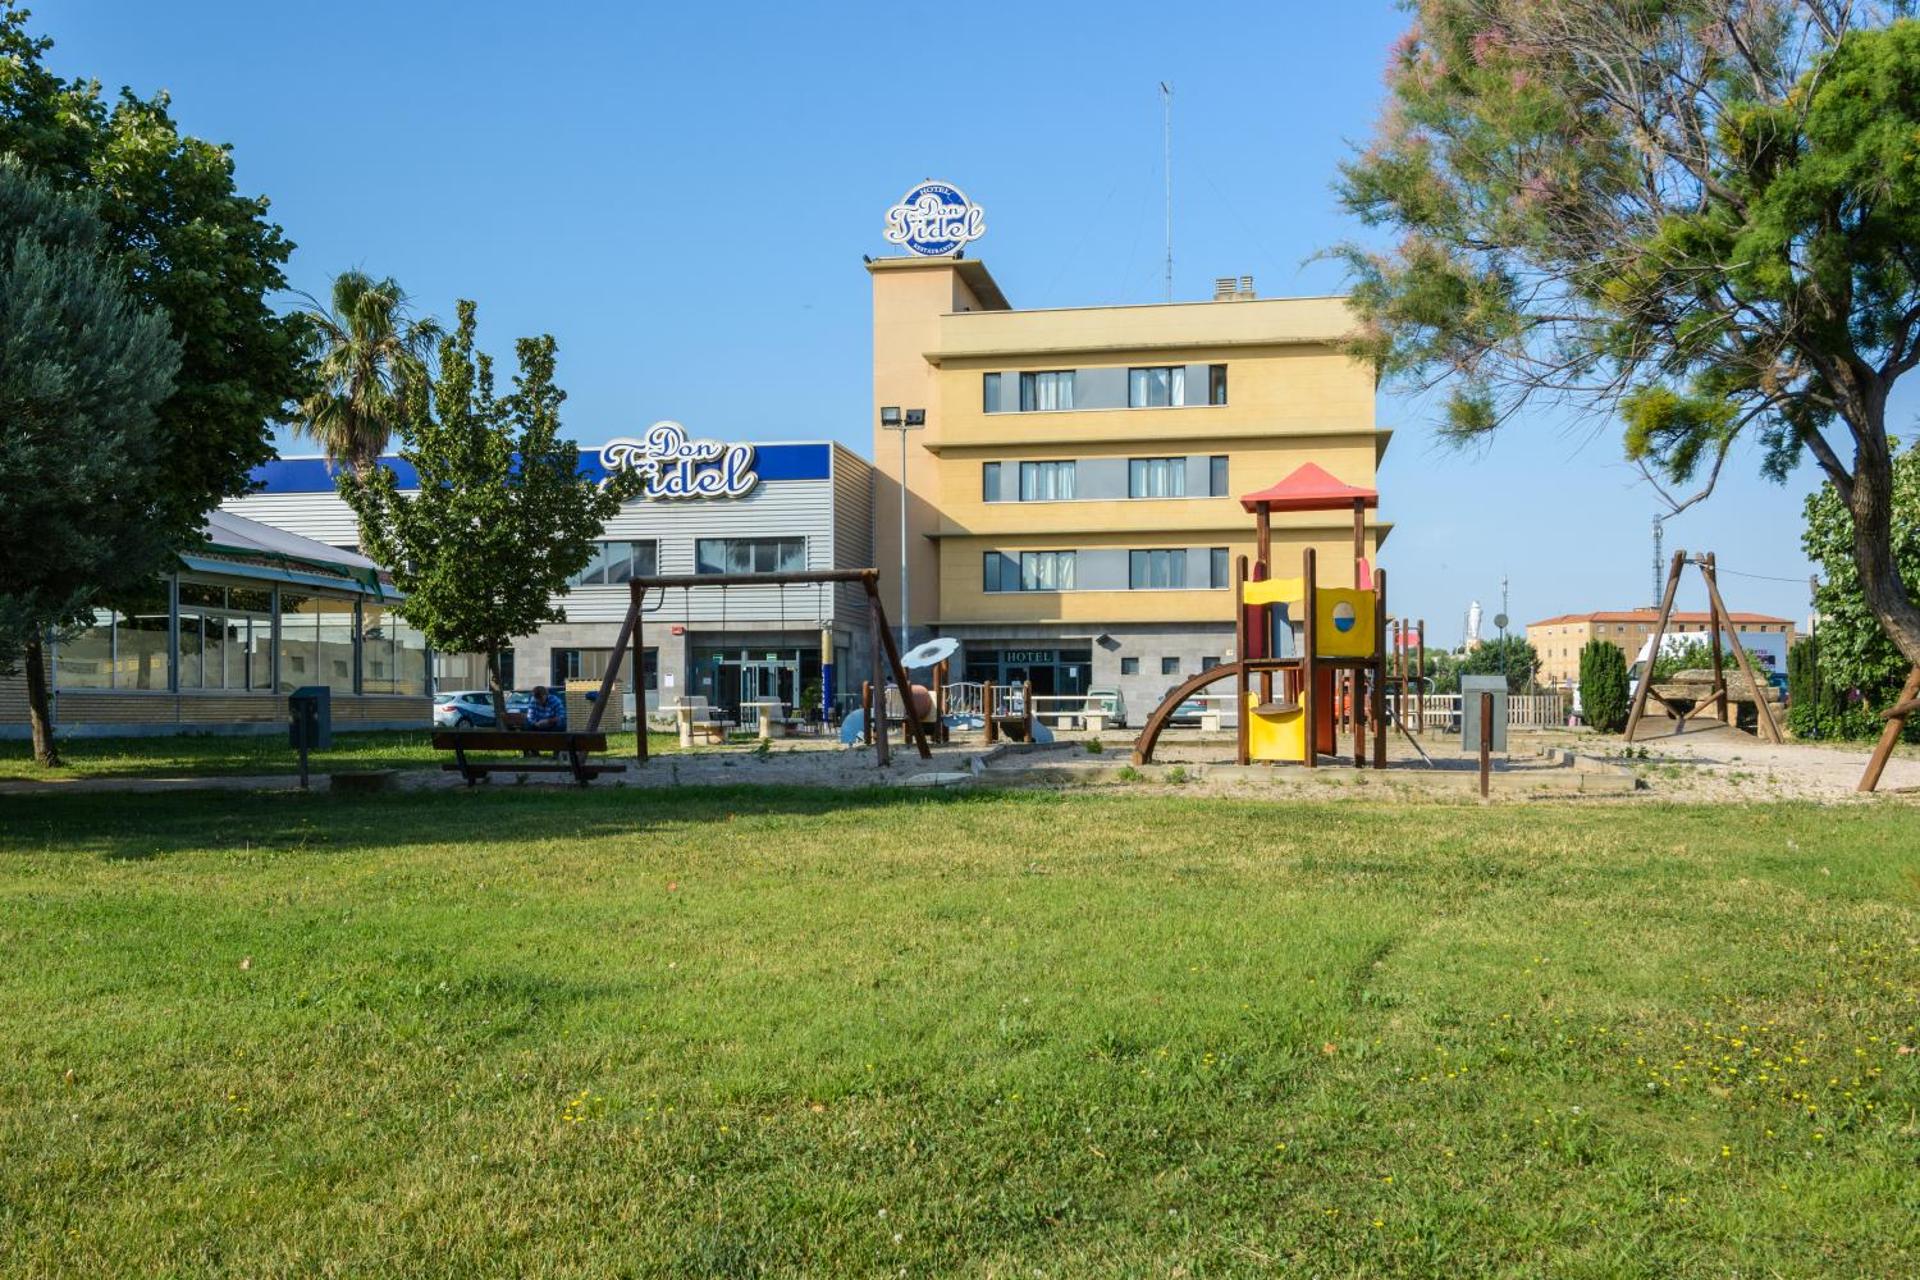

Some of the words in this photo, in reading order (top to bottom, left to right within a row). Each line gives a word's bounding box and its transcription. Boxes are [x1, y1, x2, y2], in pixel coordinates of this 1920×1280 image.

[919, 187, 951, 196] HOTEL
[918, 196, 964, 216] Don
[888, 207, 984, 241] Fidel
[913, 242, 955, 254] RESTAURANTE
[648, 425, 720, 458] Don
[602, 442, 756, 496] Fidel
[1007, 652, 1052, 663] HOTEL
